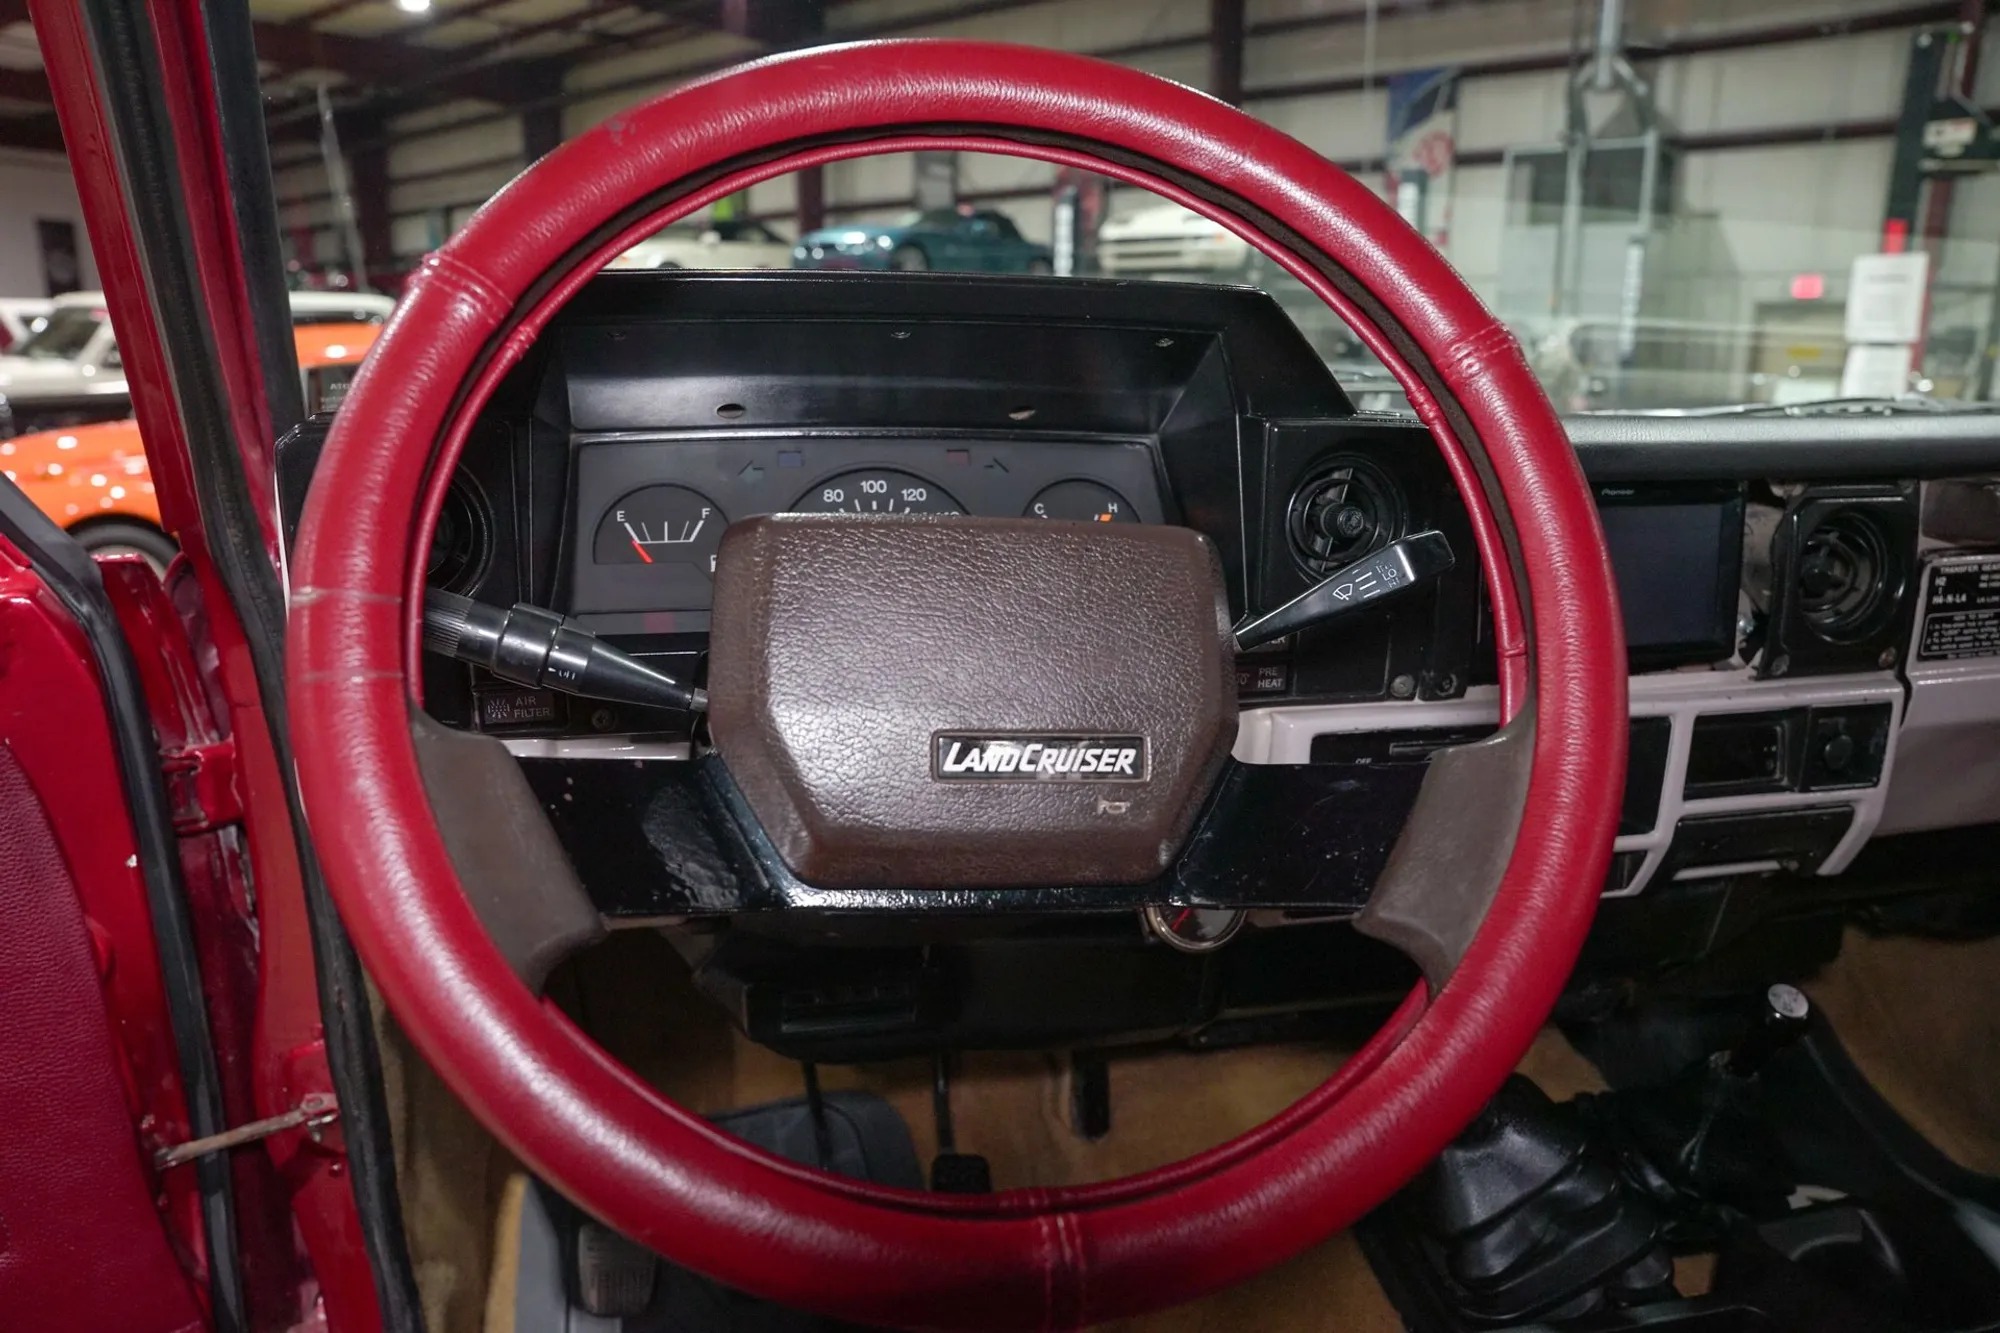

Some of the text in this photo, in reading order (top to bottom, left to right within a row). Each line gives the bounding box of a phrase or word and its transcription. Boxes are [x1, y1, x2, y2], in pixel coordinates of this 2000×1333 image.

[860, 480, 887, 493] 100
[1602, 488, 1634, 496] Pioneer
[823, 489, 844, 503] 80
[901, 488, 927, 502] 120
[1034, 503, 1045, 514] C
[1108, 502, 1118, 513] H
[617, 510, 625, 522] E
[702, 508, 711, 519] F
[1382, 568, 1397, 581] LO
[1258, 667, 1278, 676] PRE
[1257, 678, 1283, 689] HEAT
[516, 696, 537, 706] AIR
[513, 707, 550, 718] FILTER
